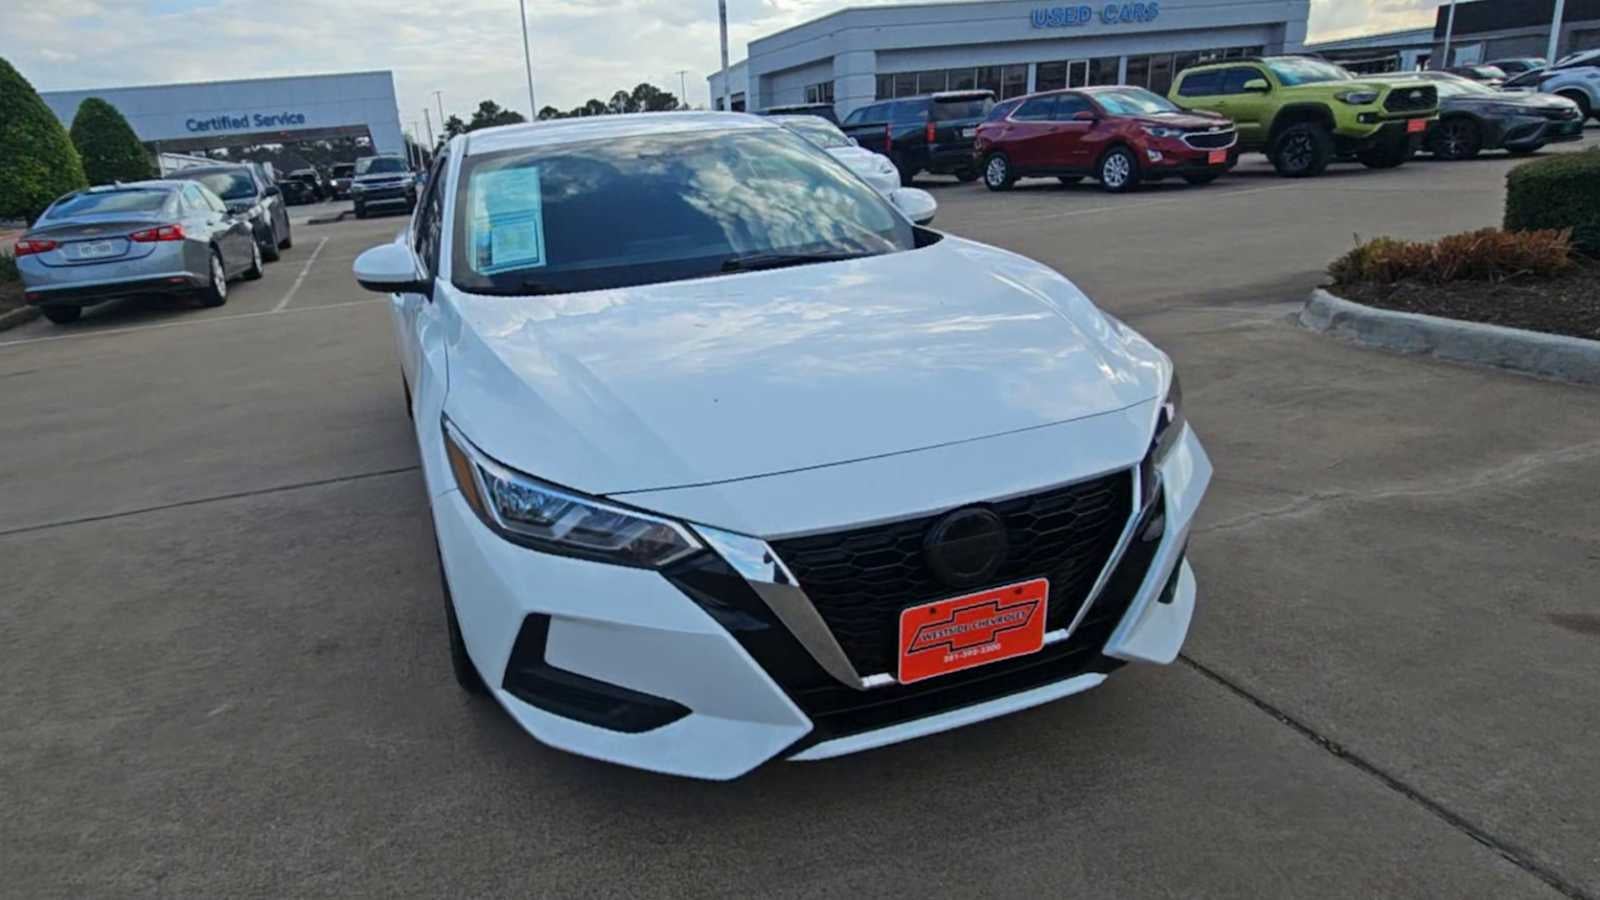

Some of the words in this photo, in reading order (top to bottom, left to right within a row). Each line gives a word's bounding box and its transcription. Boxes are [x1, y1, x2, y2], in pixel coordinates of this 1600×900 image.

[1031, 6, 1092, 28] USED
[1101, 2, 1159, 24] CARS
[185, 115, 249, 132] Certified
[253, 112, 305, 128] Service
[921, 624, 969, 641] WESTSIDE
[970, 611, 1026, 630] CHEVROLET
